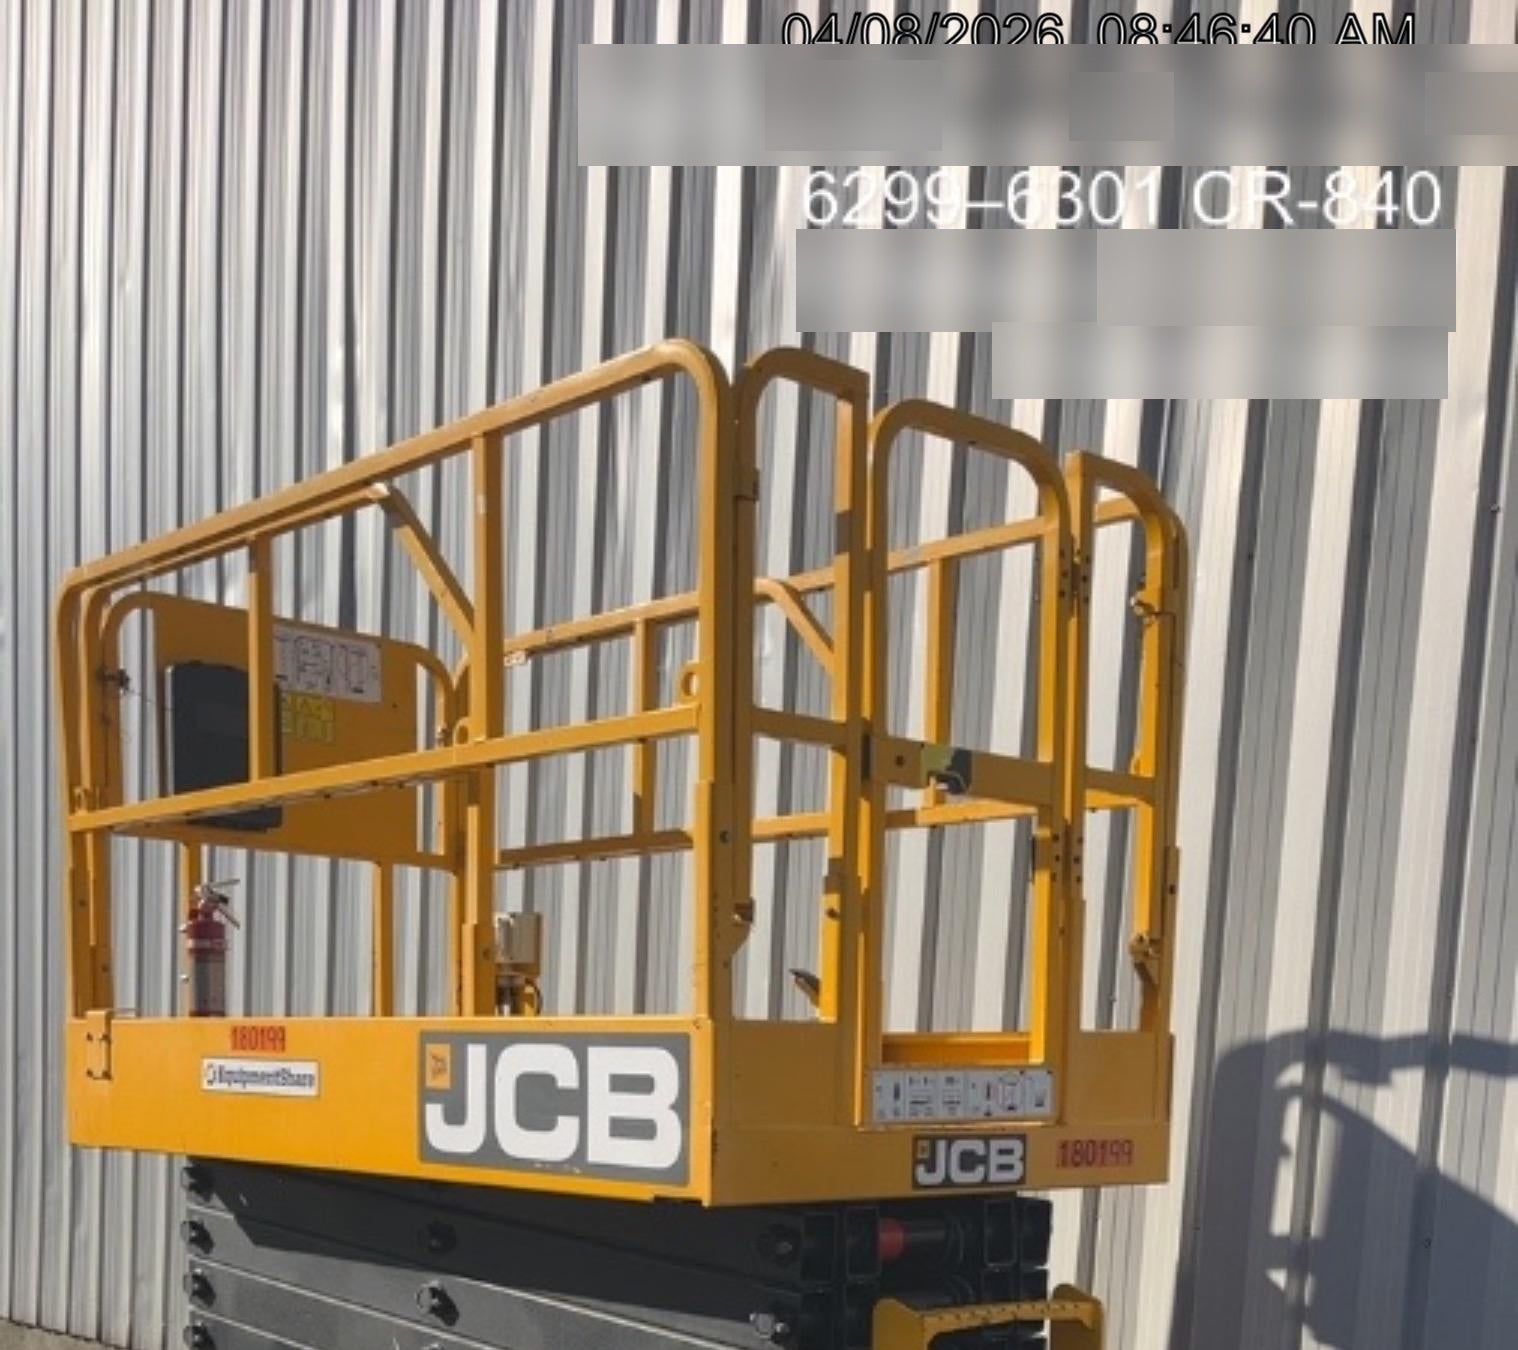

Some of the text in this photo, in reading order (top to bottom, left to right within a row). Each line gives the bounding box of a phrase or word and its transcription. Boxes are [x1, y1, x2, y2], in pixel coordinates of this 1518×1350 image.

[231, 1026, 286, 1052] 180199
[218, 1064, 315, 1089] EquipmentShare
[425, 1043, 682, 1169] JCB
[915, 1139, 1024, 1186] JCB
[1056, 1139, 1135, 1168] 180199
